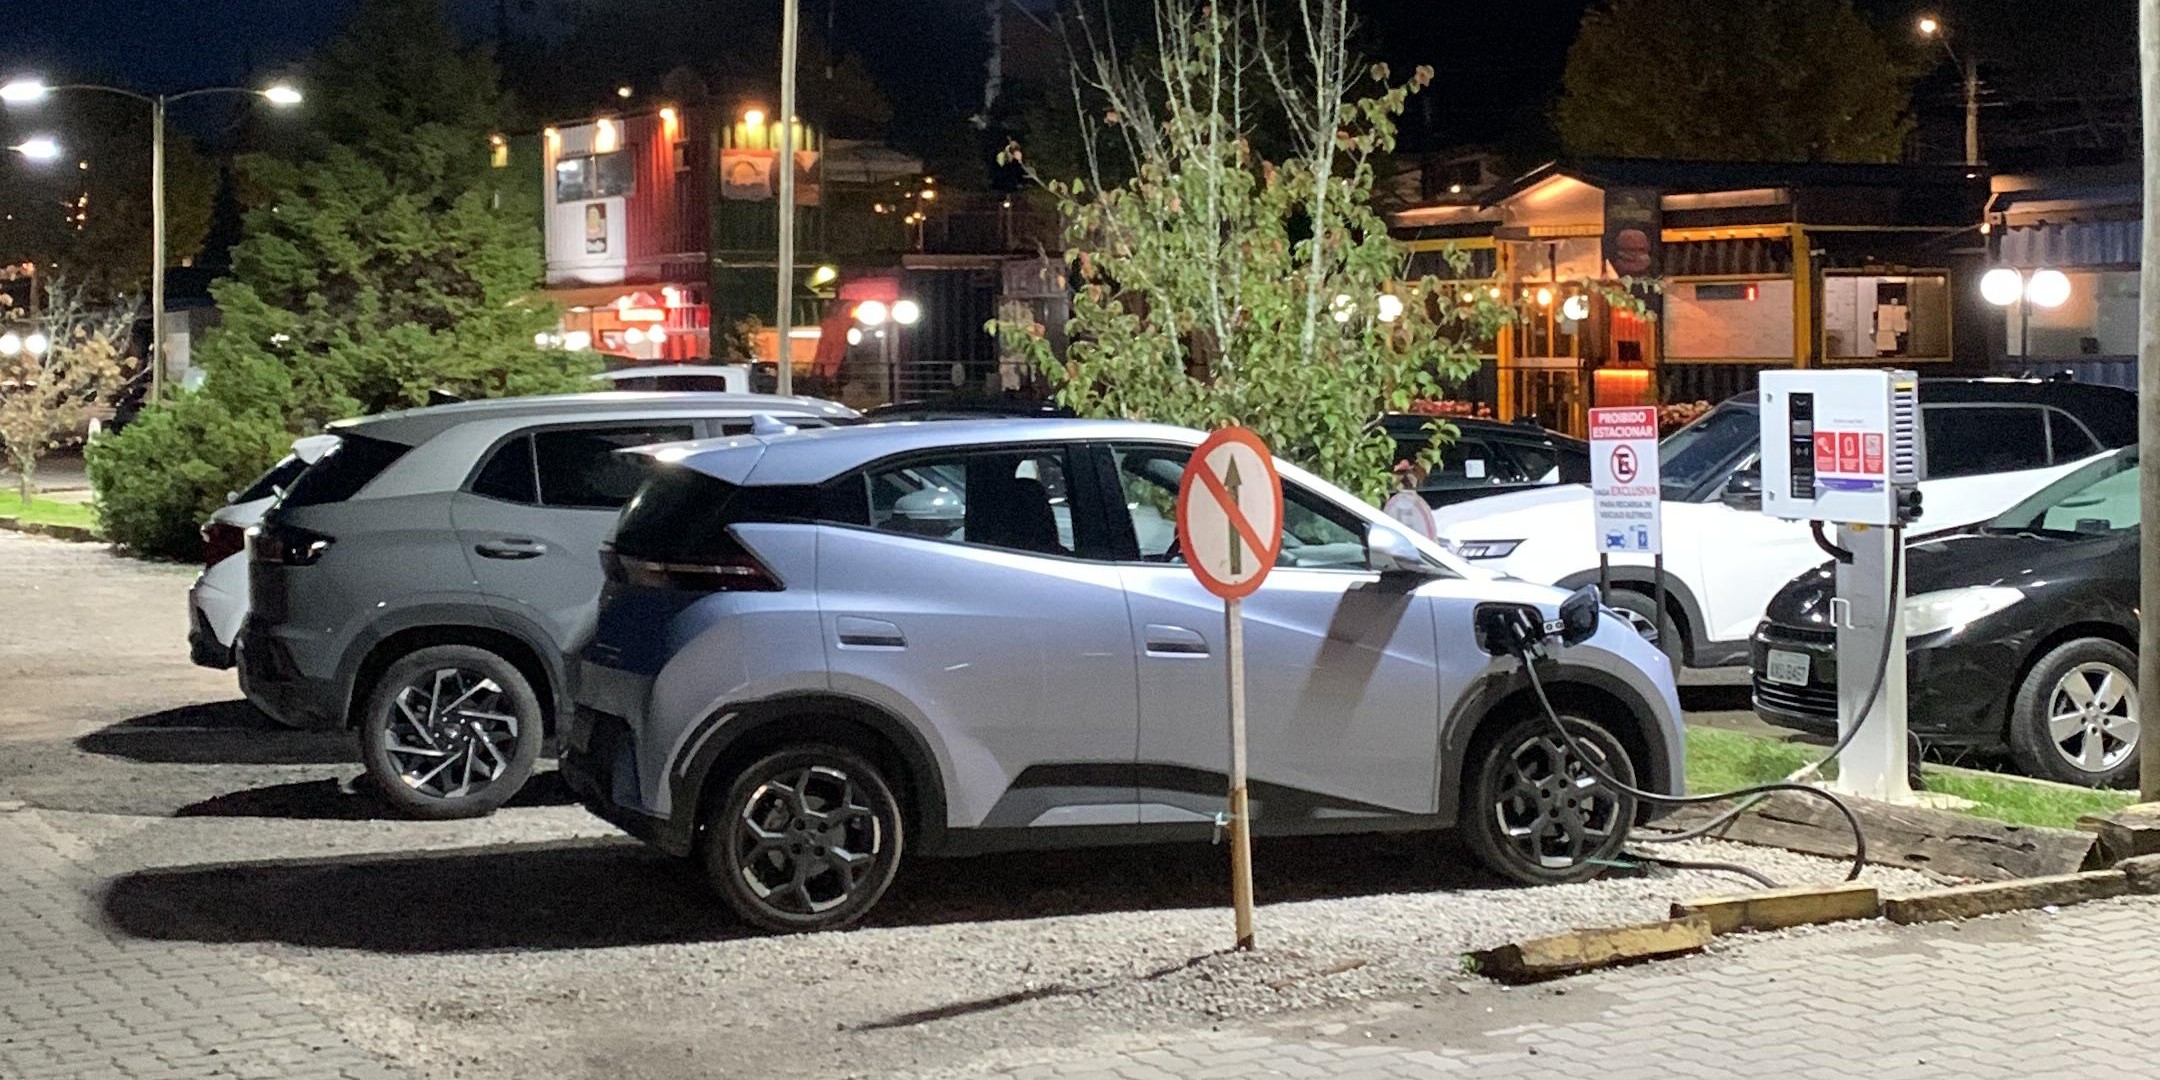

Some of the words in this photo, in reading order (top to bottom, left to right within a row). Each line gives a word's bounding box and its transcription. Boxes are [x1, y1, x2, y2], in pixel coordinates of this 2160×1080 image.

[1598, 412, 1646, 424] PROIBIDO
[1593, 426, 1653, 438] ESTACIONAR
[1611, 486, 1657, 496] EXCLUSIVA
